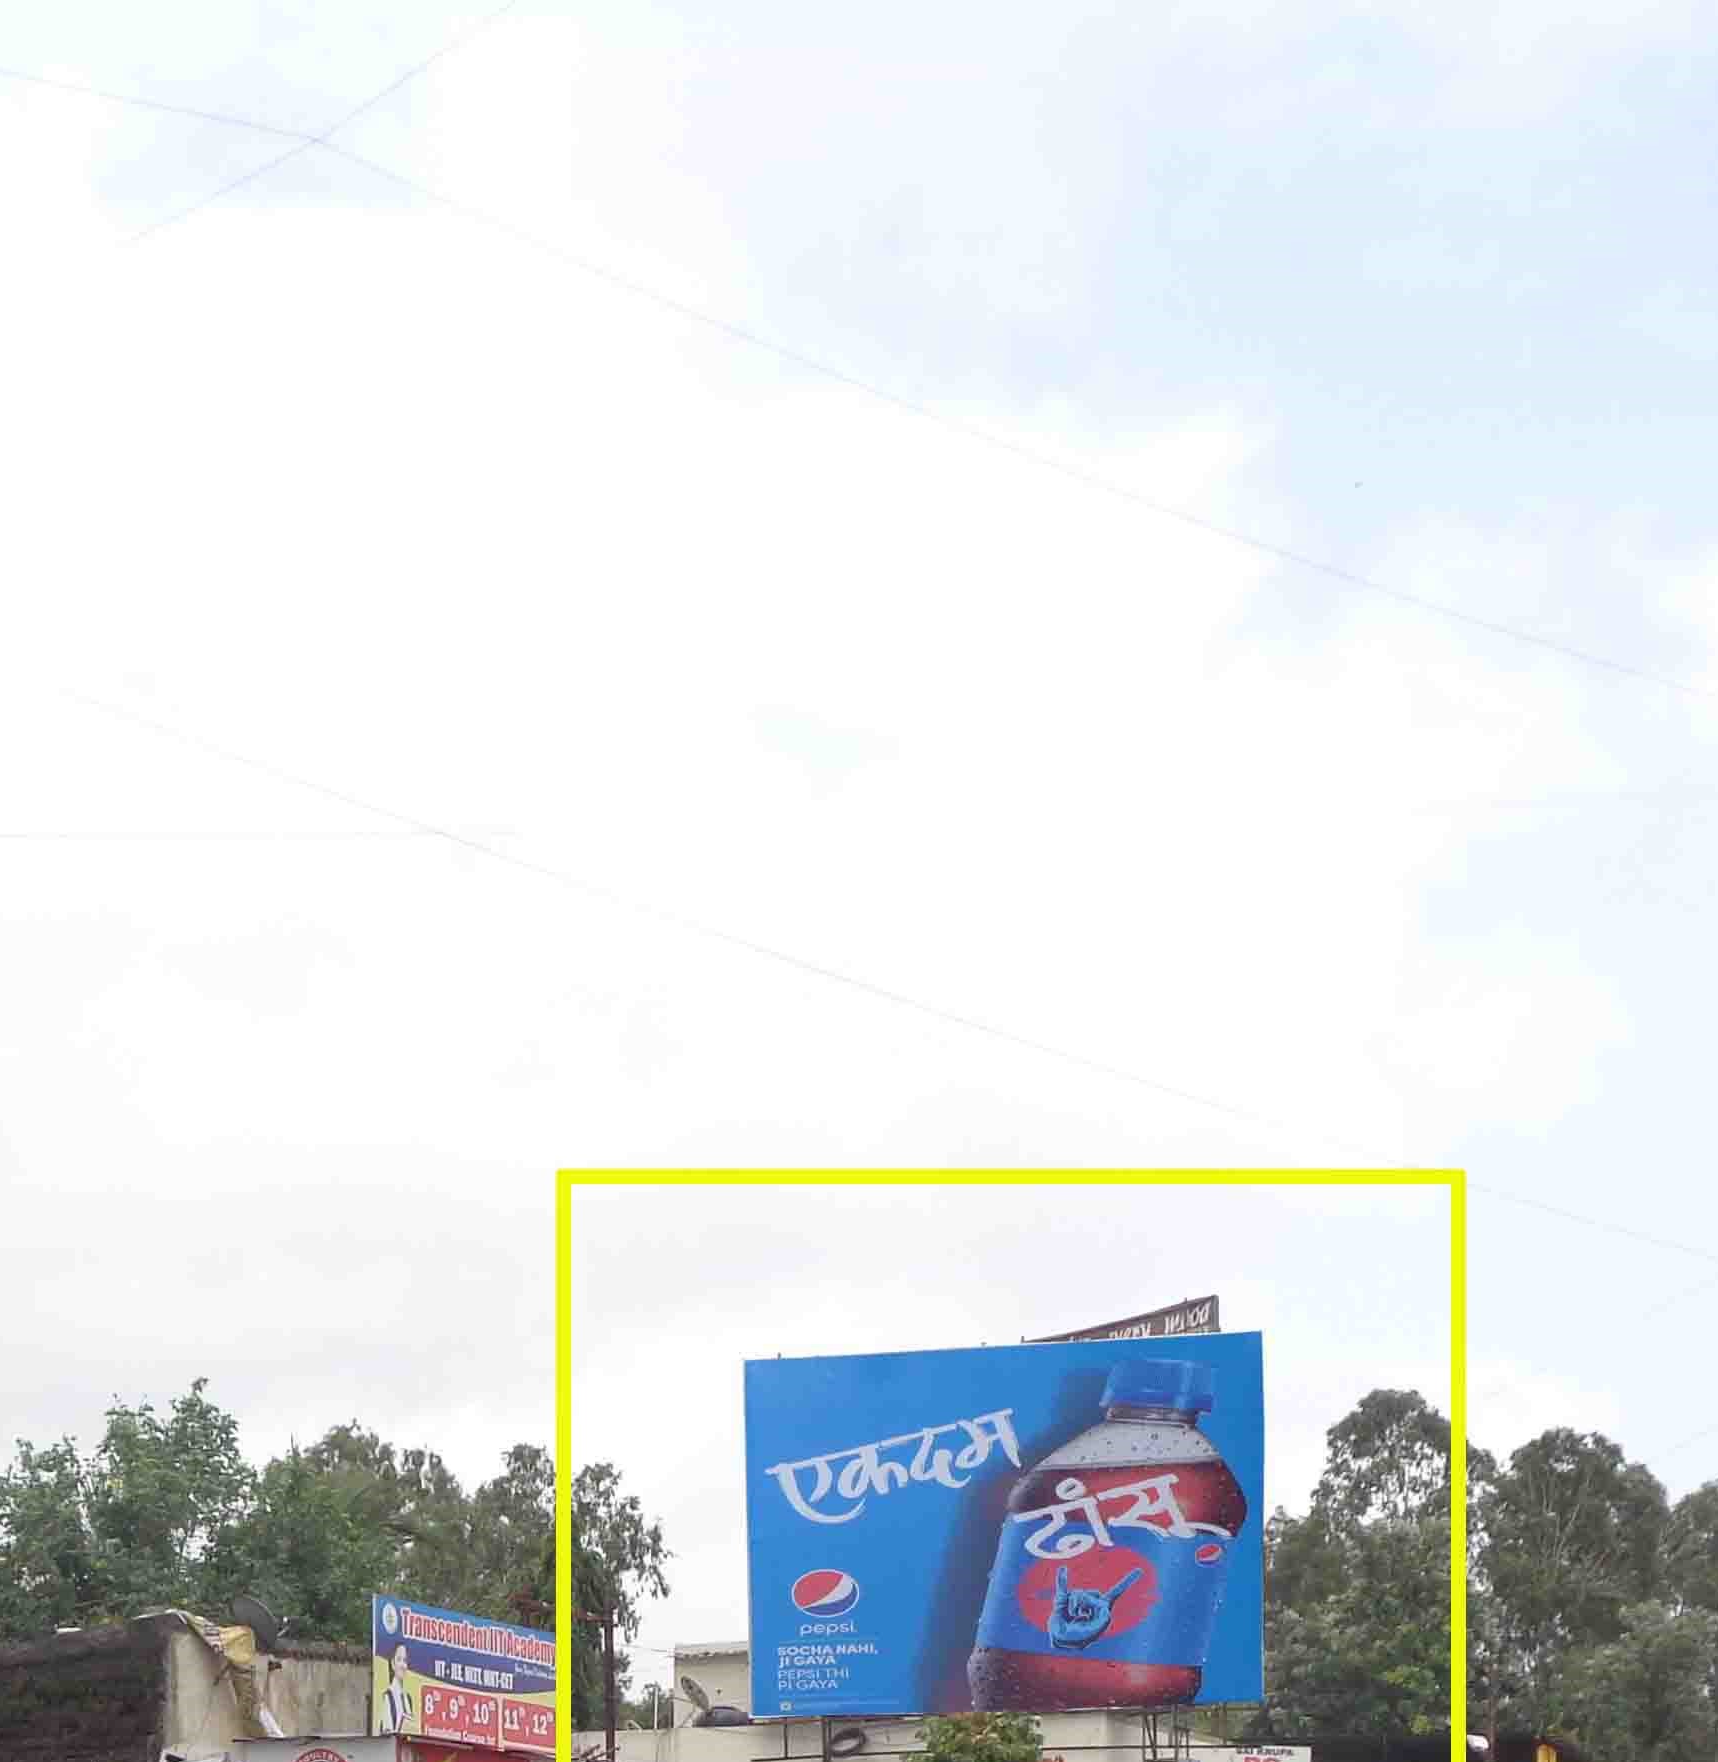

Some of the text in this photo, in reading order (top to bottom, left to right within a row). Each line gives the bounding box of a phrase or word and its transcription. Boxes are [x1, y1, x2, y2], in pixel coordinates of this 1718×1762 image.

[764, 1408, 1021, 1523] एकदम
[400, 1606, 490, 1654] Transcendent
[777, 1643, 878, 1656] SOCHA NAHI,
[779, 1655, 835, 1668] JI GAYA
[777, 1667, 850, 1680] PEPSI THI
[777, 1679, 838, 1692] PI GAYA
